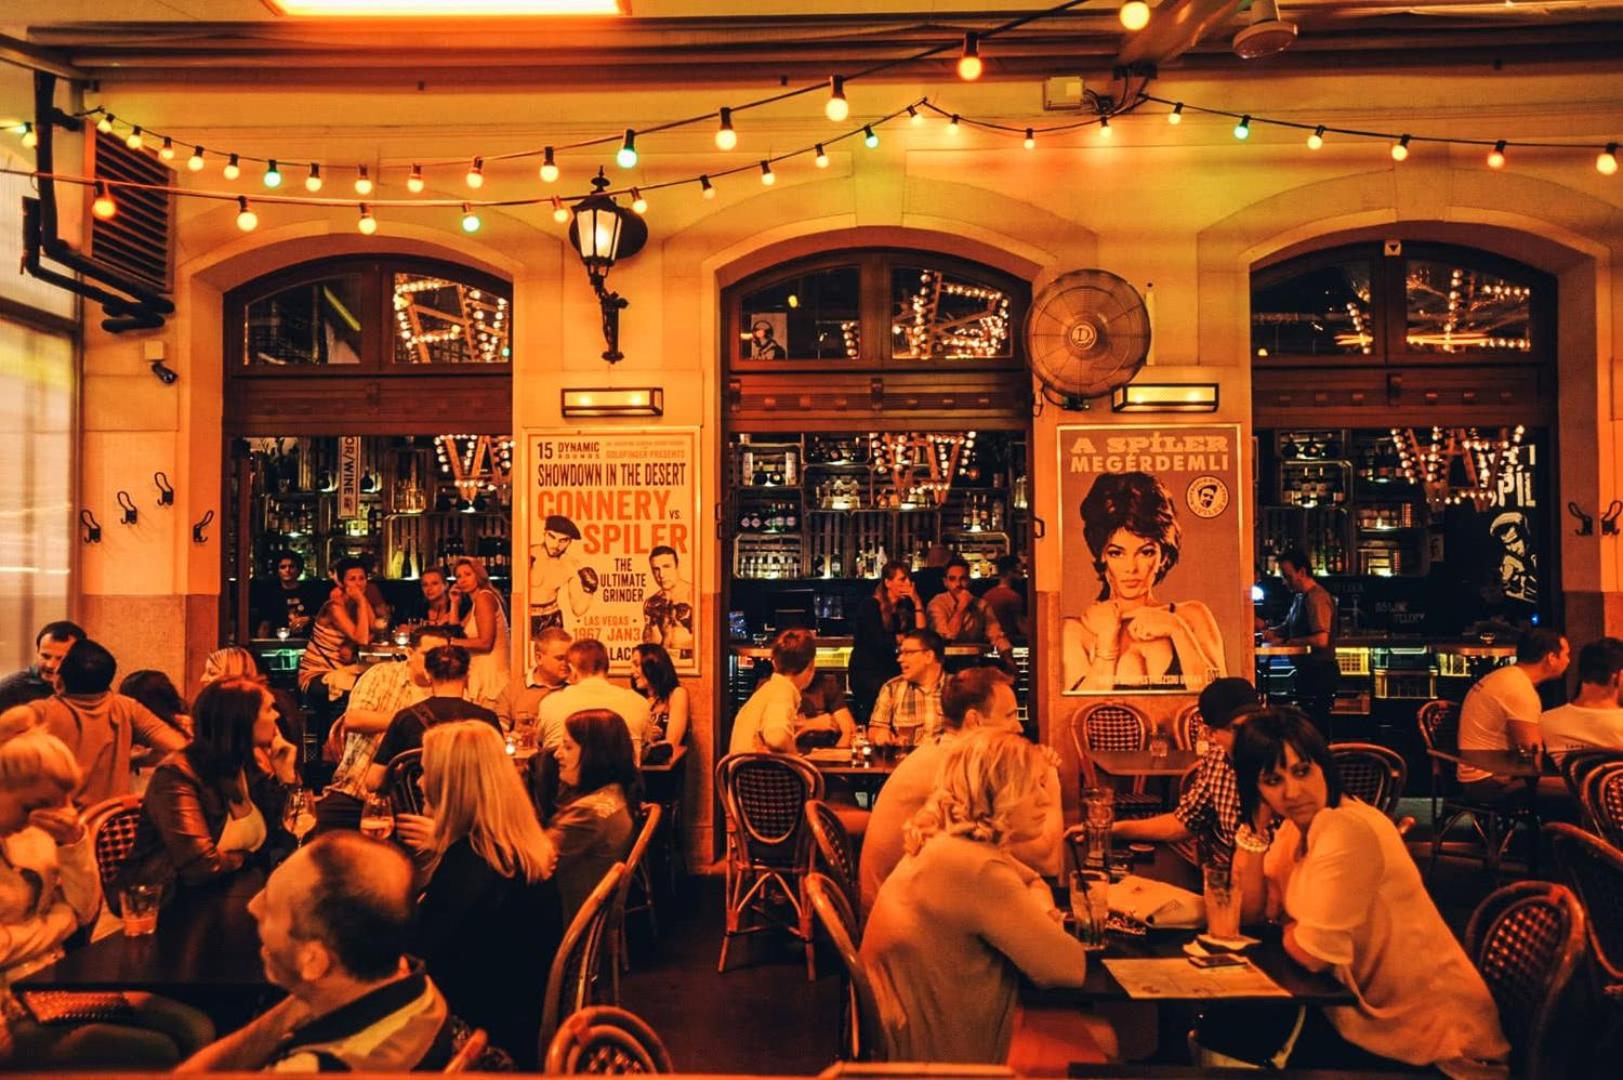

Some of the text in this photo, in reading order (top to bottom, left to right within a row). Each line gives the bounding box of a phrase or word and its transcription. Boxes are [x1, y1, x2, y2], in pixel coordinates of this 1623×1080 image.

[537, 442, 553, 460] 15
[558, 441, 600, 452] DYNAMIC
[1070, 437, 1097, 454] A
[1070, 452, 1229, 473] MEGÉRDEMLI
[538, 462, 686, 487] SHOWDOWN IN THE DESERT
[537, 489, 671, 521] CONNERY
[583, 523, 689, 555] SPILER
[614, 558, 633, 572] THE
[600, 573, 647, 587] ULTIMATE
[602, 588, 644, 603] GRINDER
[584, 615, 629, 626] LAS VEGAS
[573, 627, 601, 641] 1967
[609, 646, 632, 661] LAC
